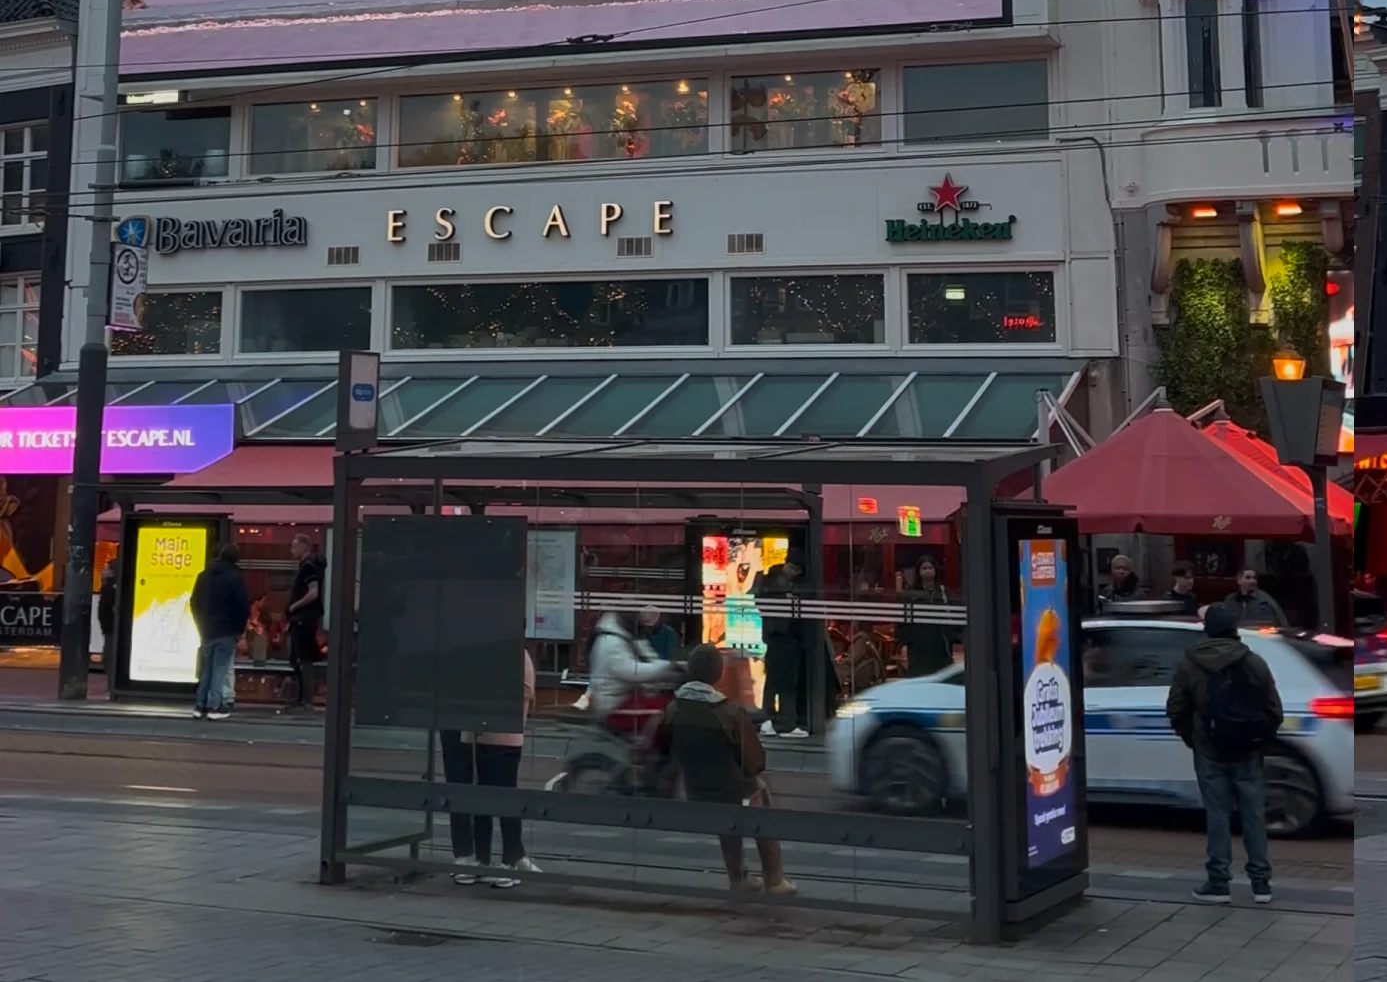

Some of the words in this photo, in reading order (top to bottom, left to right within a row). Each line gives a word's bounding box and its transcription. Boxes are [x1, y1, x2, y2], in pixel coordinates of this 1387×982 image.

[155, 208, 308, 254] Bavaria
[387, 200, 675, 243] ESCAPE
[885, 217, 1013, 242] Heineken
[106, 429, 196, 447] ESCAPE.NL
[154, 536, 189, 551] Main
[150, 552, 192, 570] stage
[0, 605, 53, 626] CAPE
